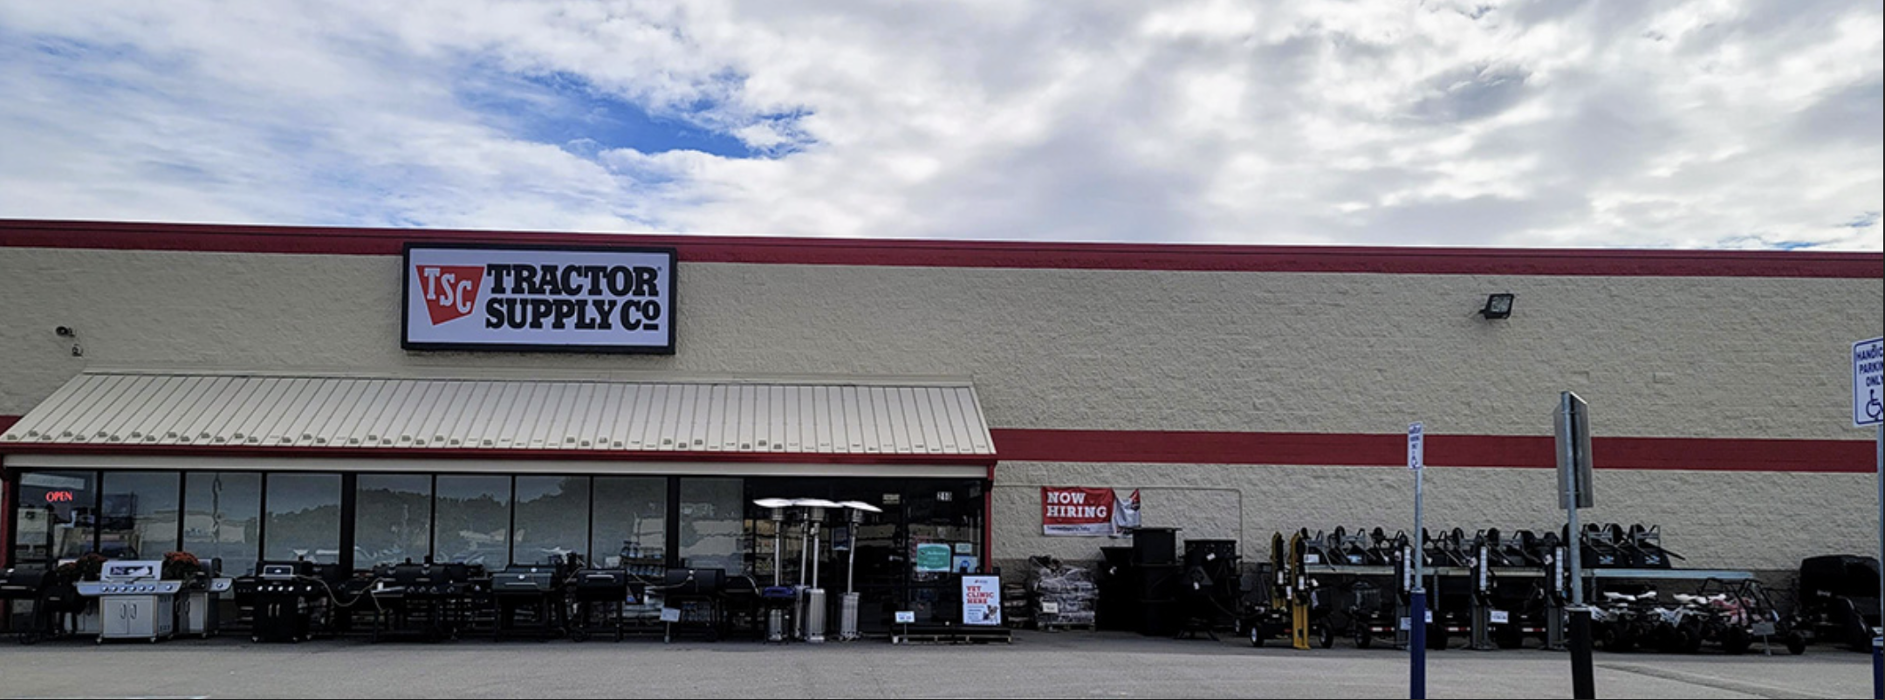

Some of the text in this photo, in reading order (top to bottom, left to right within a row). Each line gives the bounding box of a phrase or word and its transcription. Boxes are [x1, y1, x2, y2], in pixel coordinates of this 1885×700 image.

[424, 268, 472, 314] TSC
[486, 264, 659, 297] TRACTOR
[485, 297, 617, 330] SUPPLY
[45, 491, 73, 502] OPEN
[1046, 491, 1086, 504] NOW
[1046, 505, 1107, 518] HIRING
